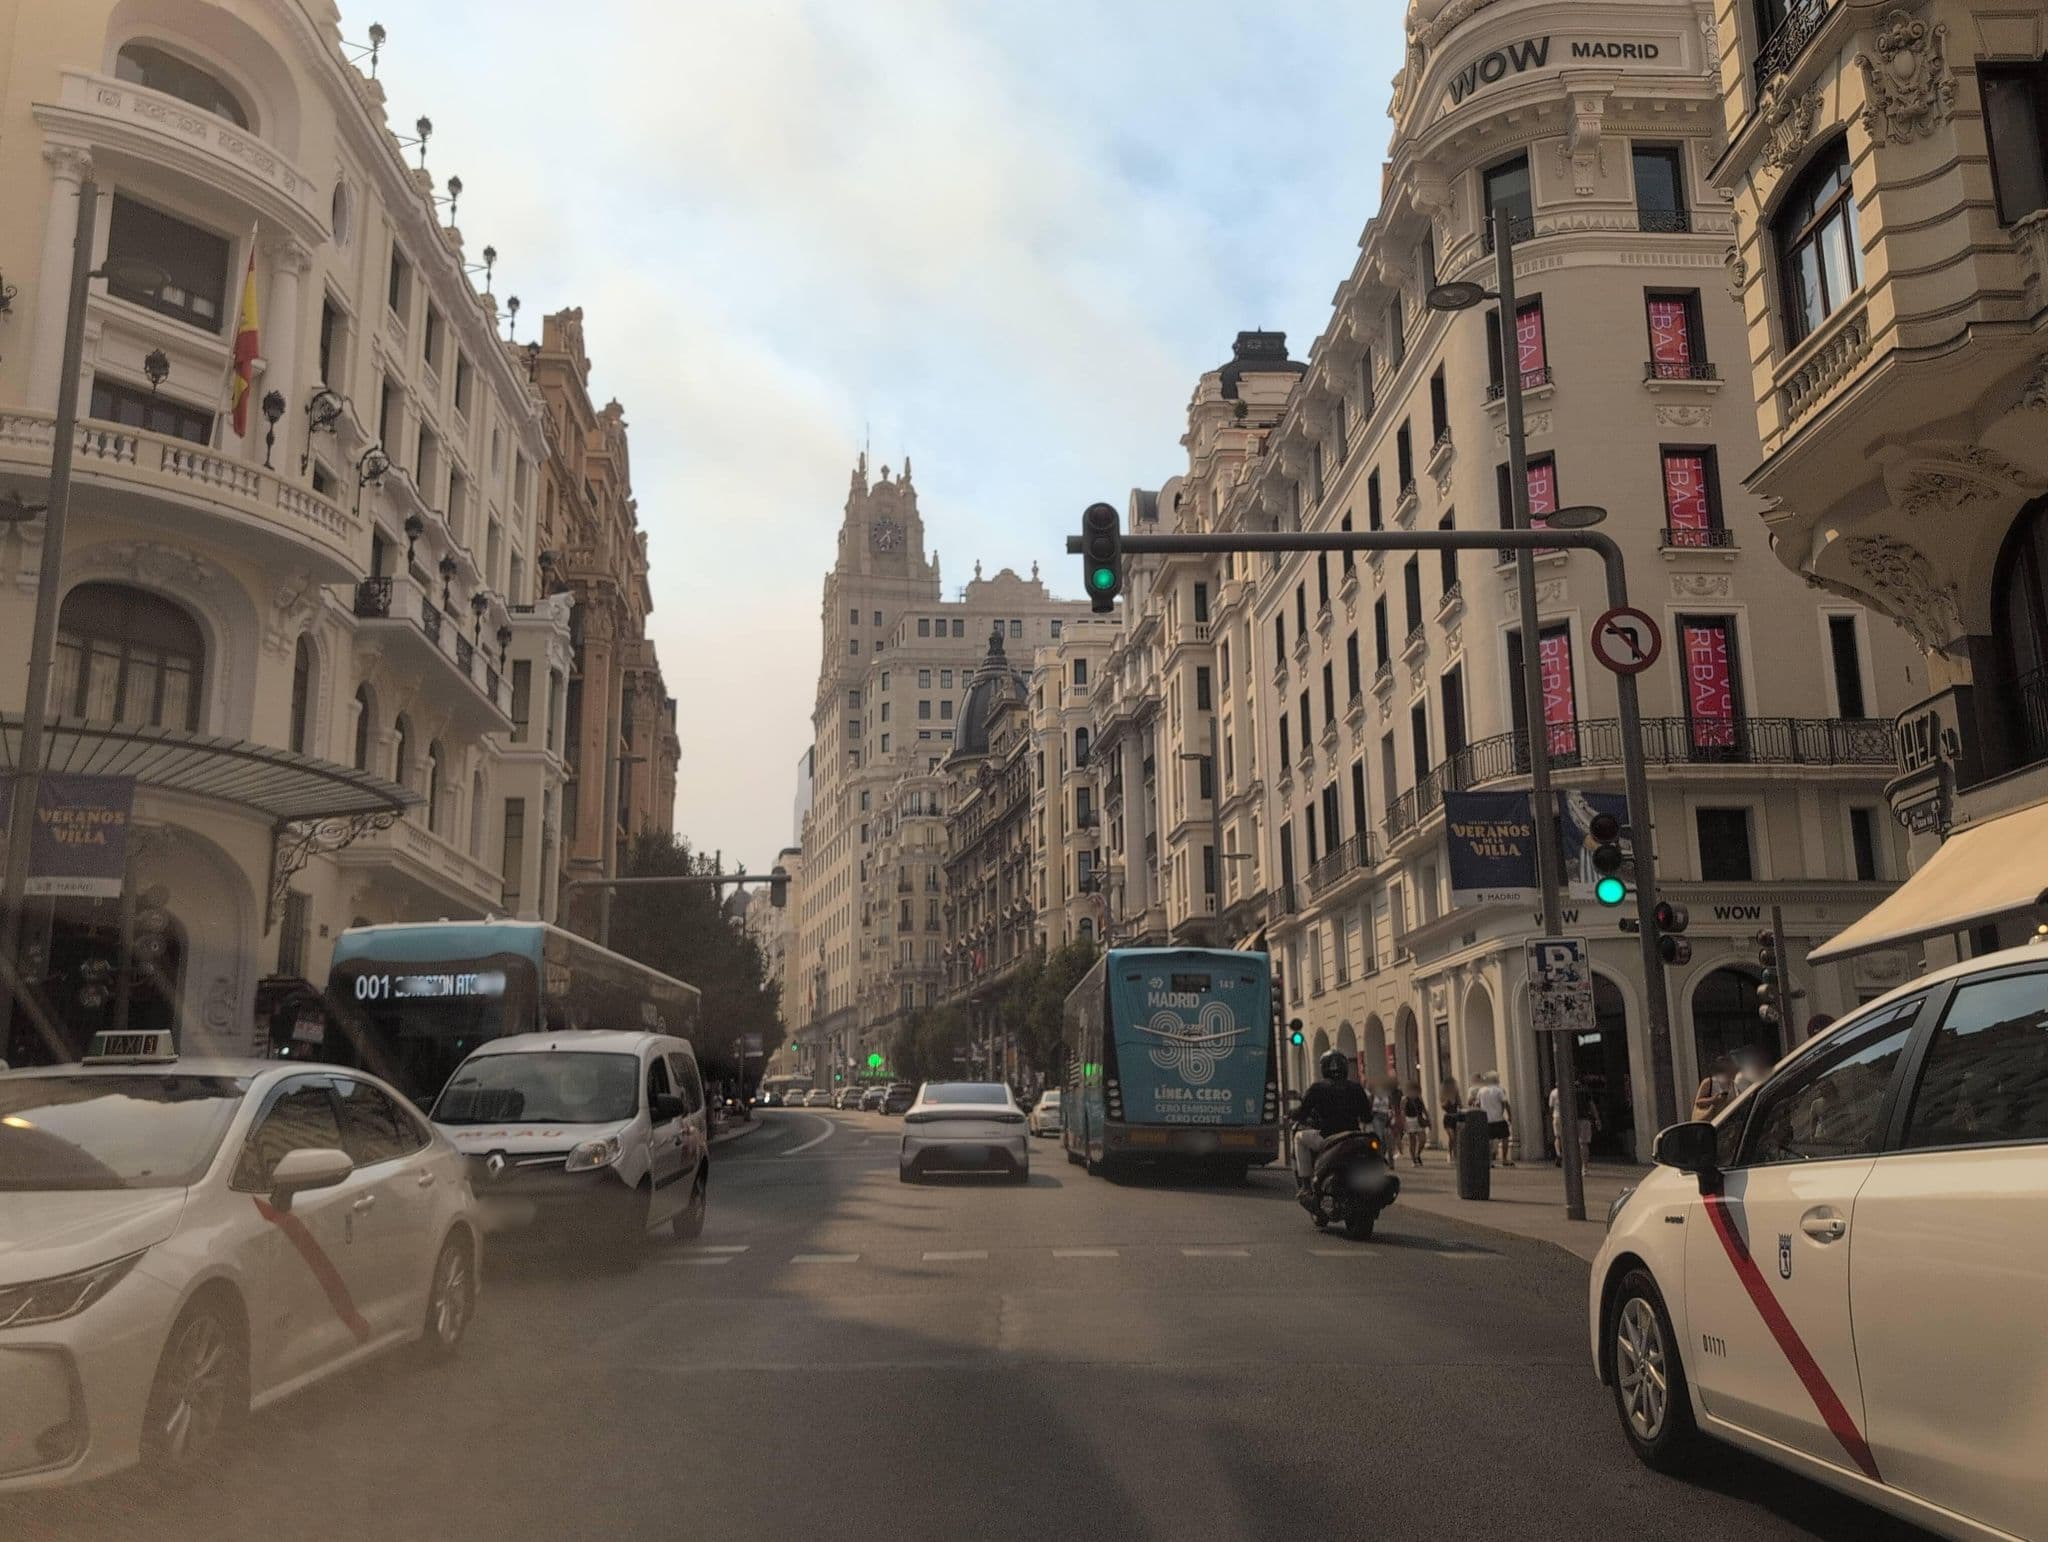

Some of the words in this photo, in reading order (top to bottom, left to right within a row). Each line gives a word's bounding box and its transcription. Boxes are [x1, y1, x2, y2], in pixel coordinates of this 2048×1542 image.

[1448, 36, 1550, 105] WOW
[1571, 43, 1659, 59] MADRID
[1451, 822, 1531, 838] VERANOS
[1470, 841, 1522, 856] VILLA
[1487, 893, 1521, 901] MADRID
[1714, 906, 1761, 920] WOW
[355, 974, 390, 999] 001
[1148, 991, 1200, 1008] MADRID
[1154, 1085, 1193, 1100] LÍNEA
[1196, 1088, 1232, 1101] CERO
[1702, 1334, 1727, 1358] 01171
